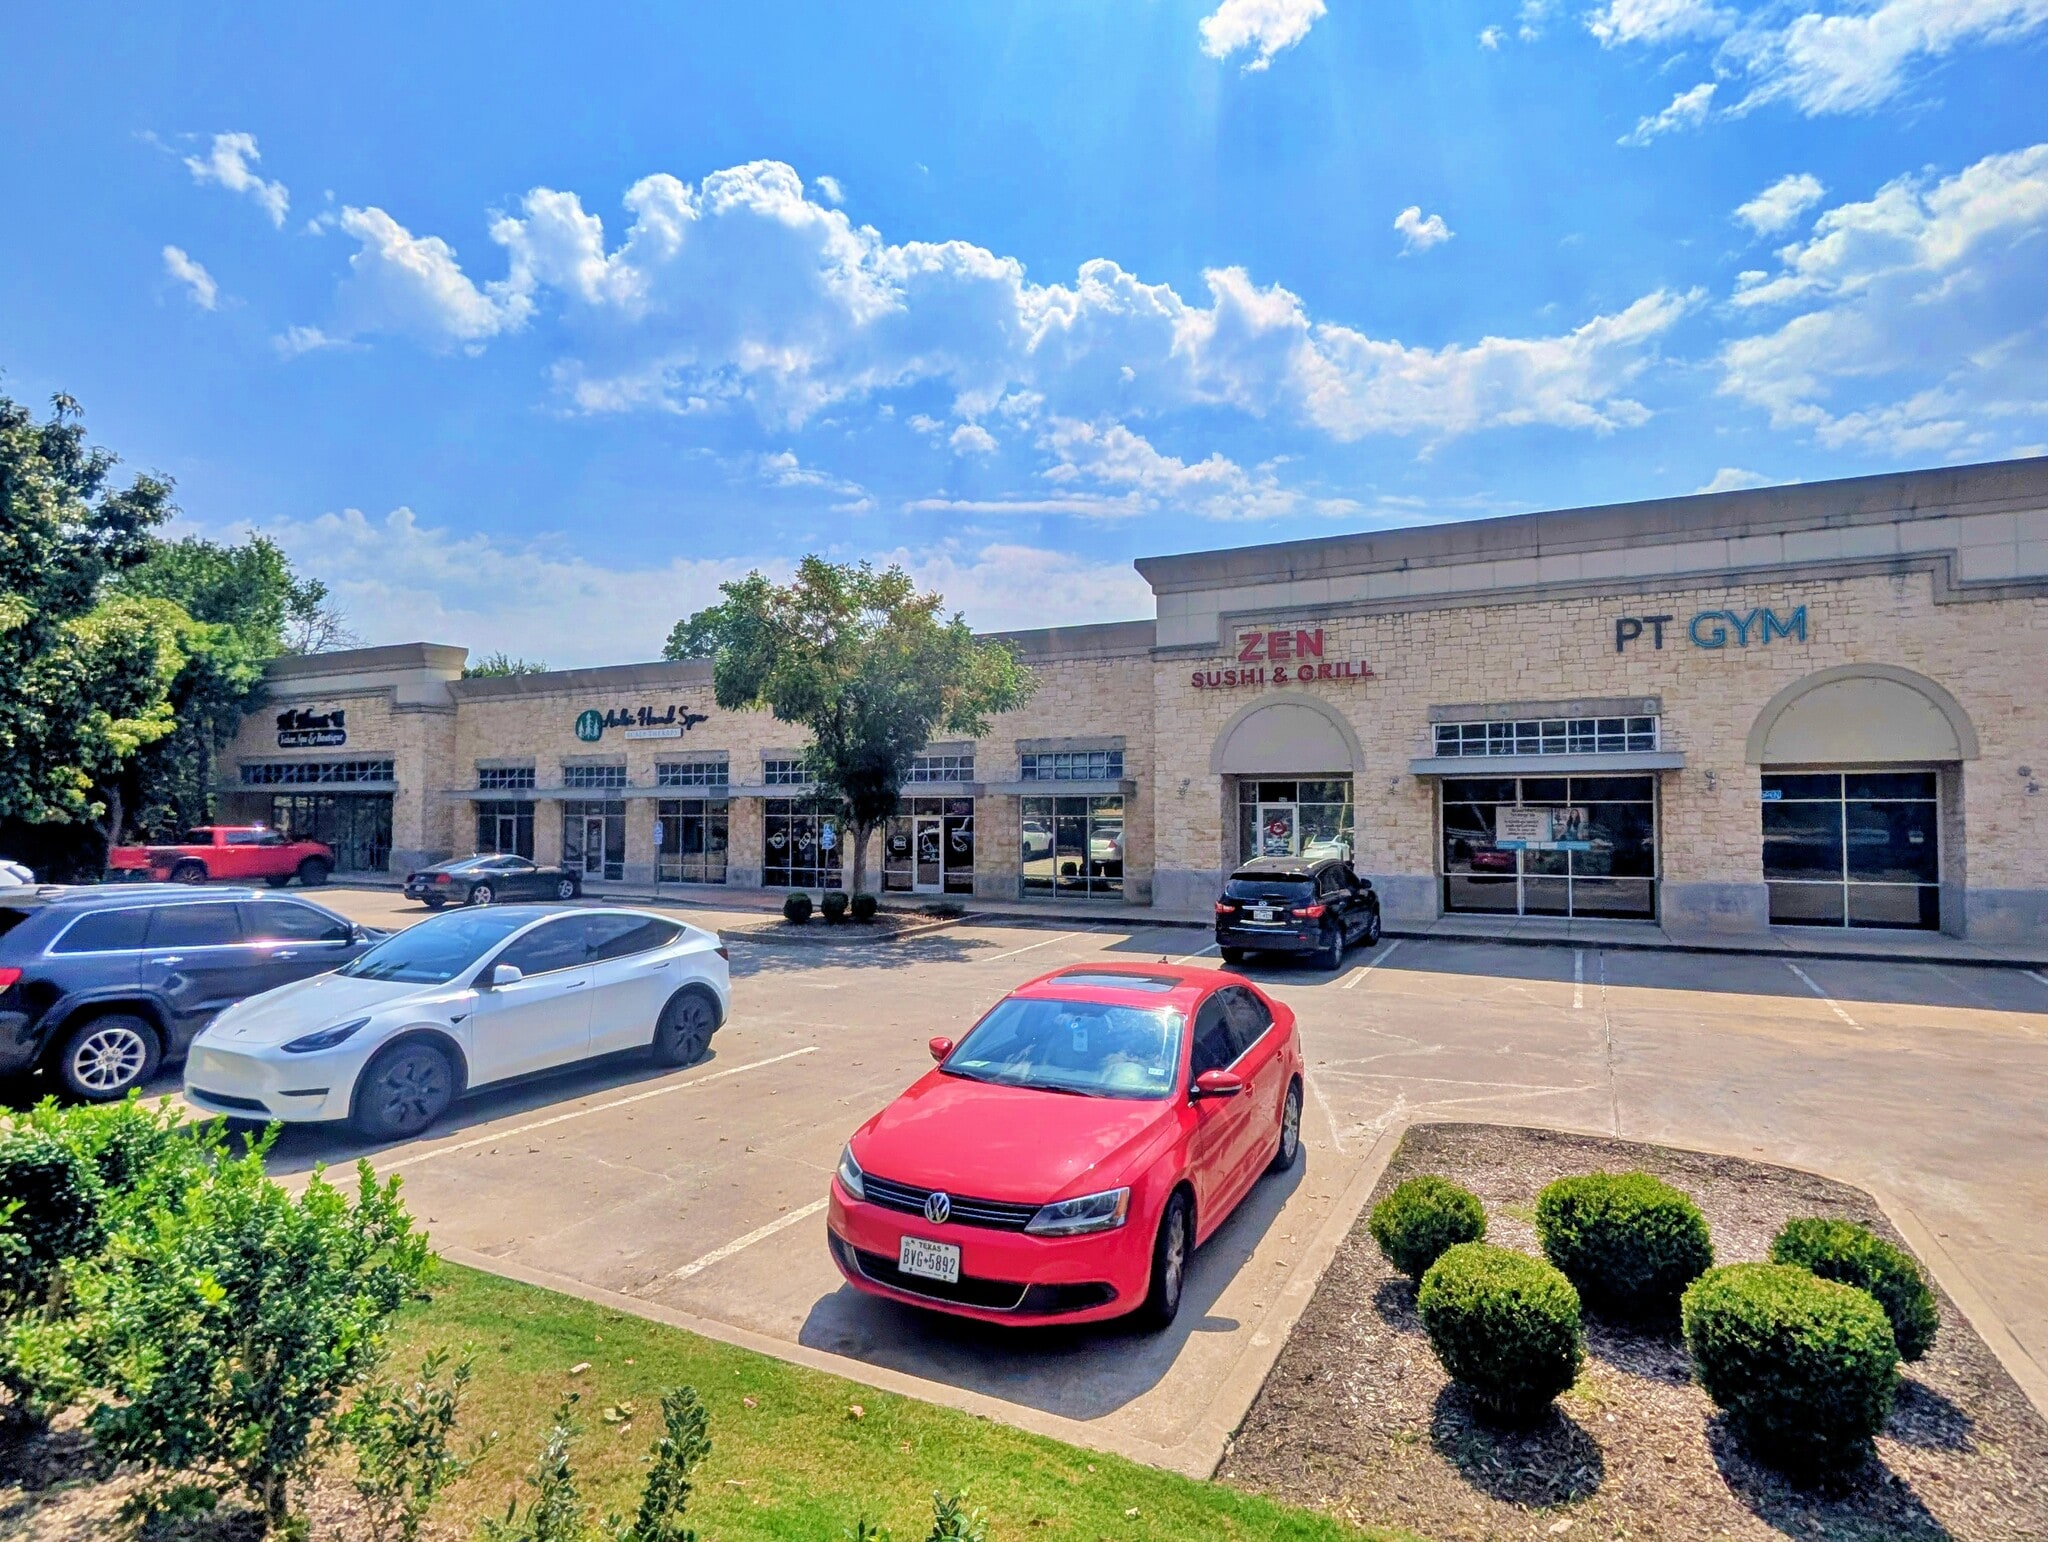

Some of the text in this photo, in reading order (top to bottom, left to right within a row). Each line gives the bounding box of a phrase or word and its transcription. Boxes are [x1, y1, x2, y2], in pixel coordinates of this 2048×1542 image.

[1616, 605, 1807, 652] PT GYM
[1238, 629, 1324, 662] ZEN
[1191, 660, 1375, 688] SUSHI & GRILL
[677, 705, 709, 730] Spa
[918, 1241, 942, 1253] TEXAS
